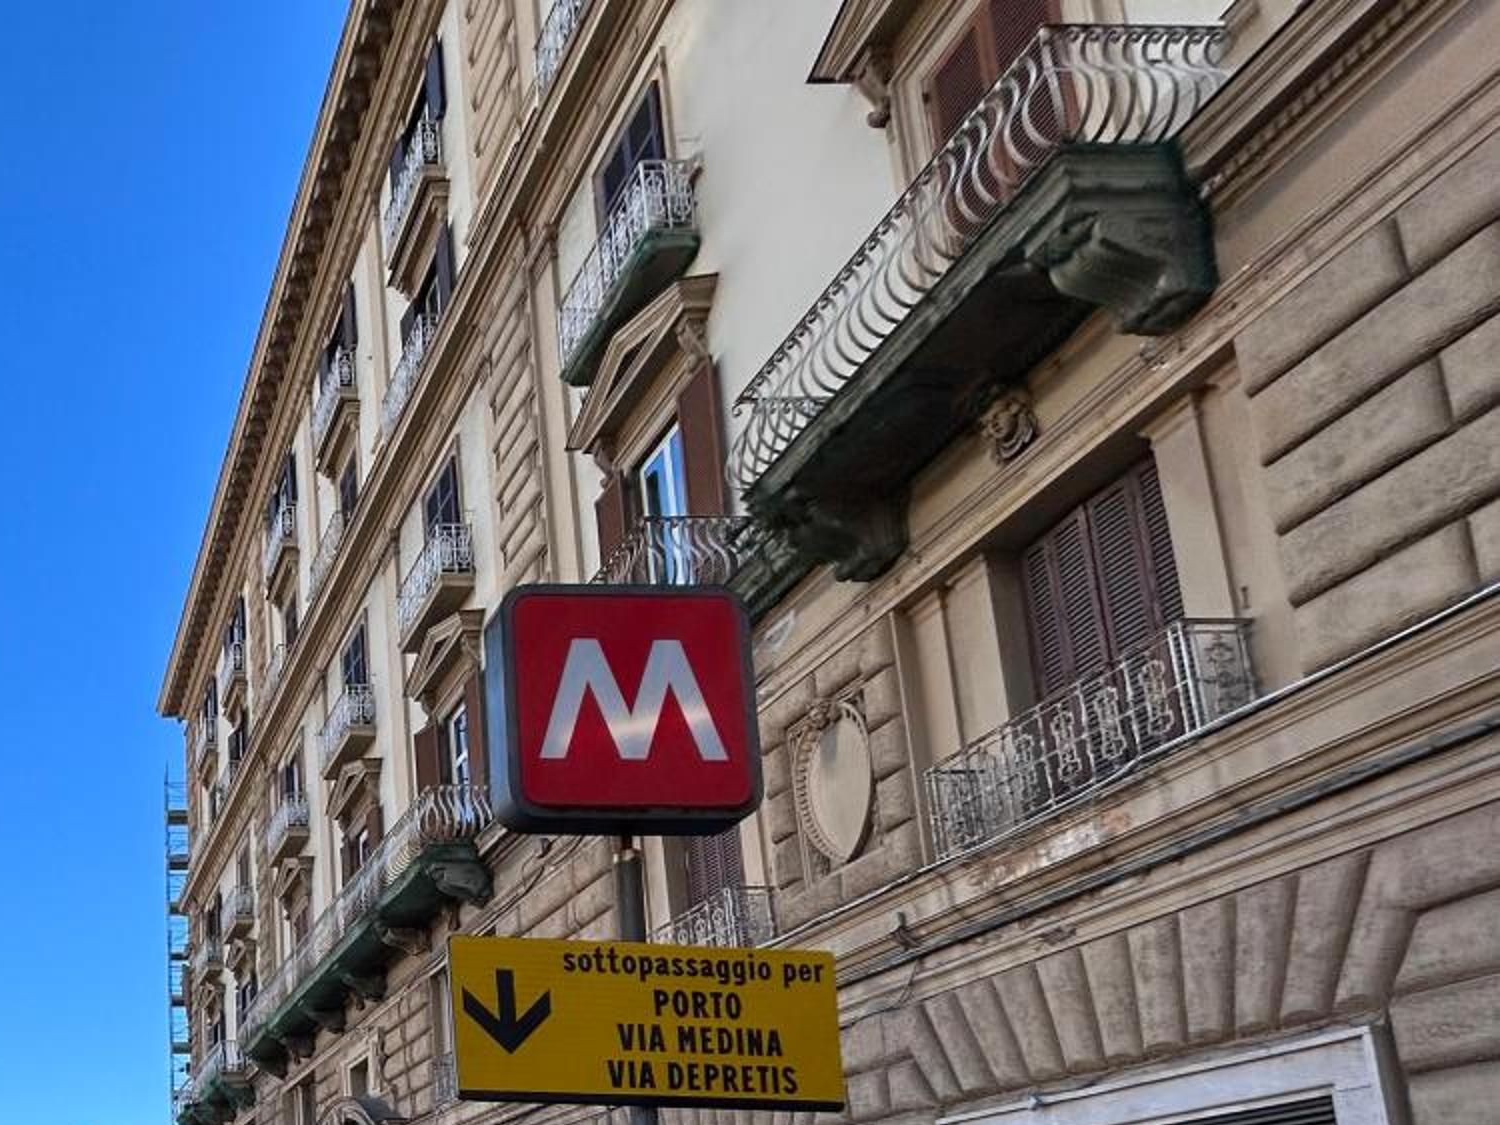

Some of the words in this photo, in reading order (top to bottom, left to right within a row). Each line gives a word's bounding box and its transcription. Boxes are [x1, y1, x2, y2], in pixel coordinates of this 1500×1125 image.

[539, 637, 729, 761] M
[563, 946, 771, 986] sottopassaggio
[783, 962, 824, 988] per
[654, 989, 742, 1020] PORTO
[617, 1023, 667, 1052] VIA
[678, 1025, 783, 1057] MEDINA
[607, 1059, 656, 1089] VIA
[667, 1061, 798, 1095] DEPRETIS
